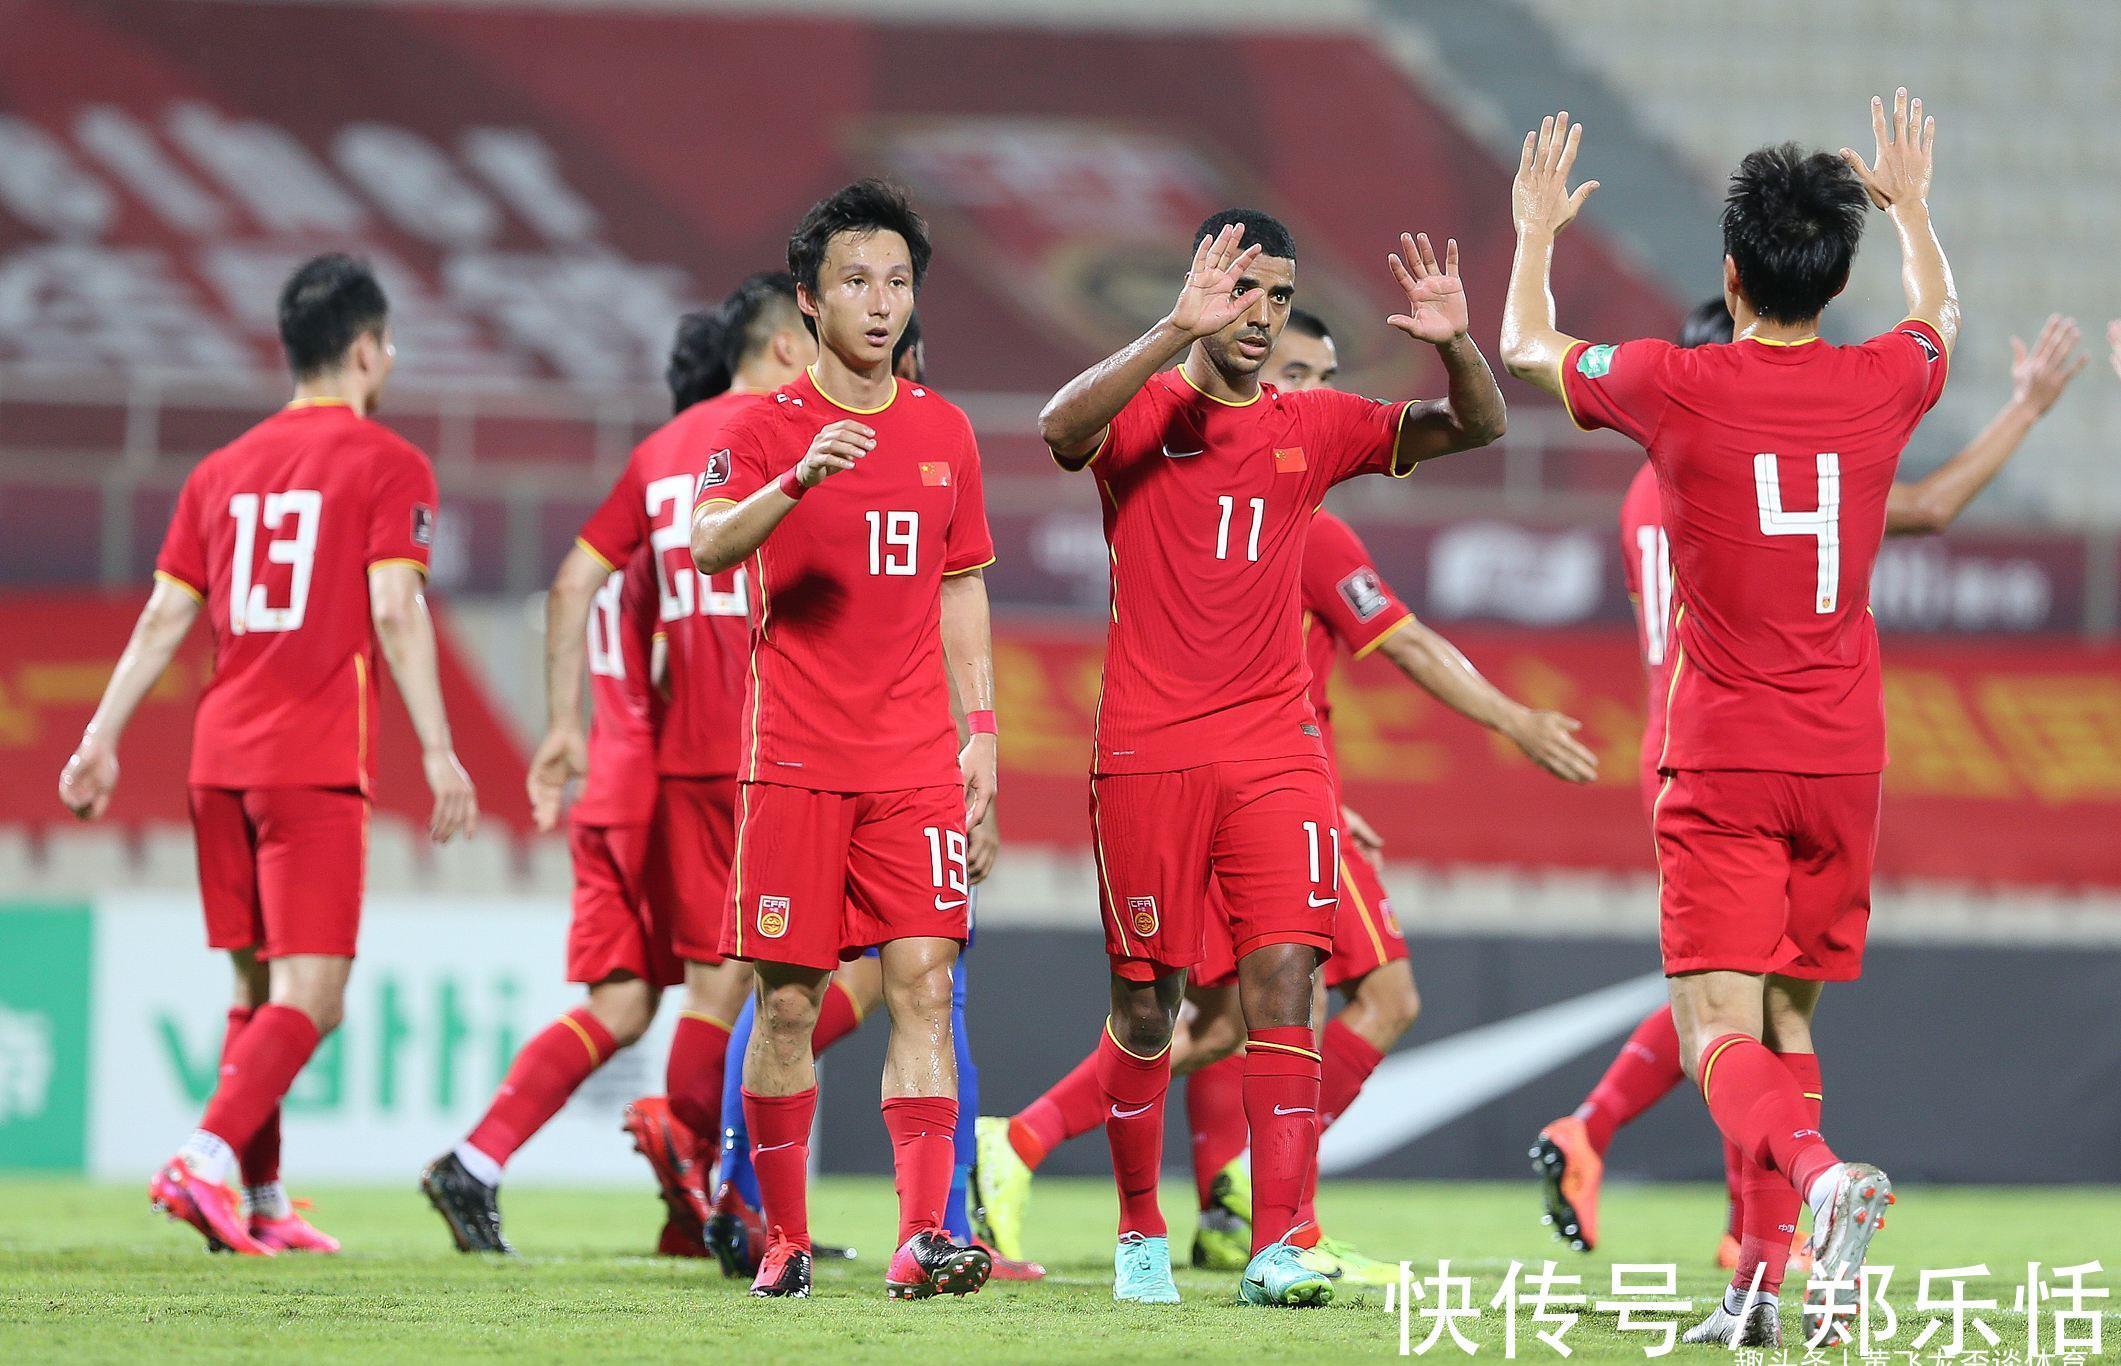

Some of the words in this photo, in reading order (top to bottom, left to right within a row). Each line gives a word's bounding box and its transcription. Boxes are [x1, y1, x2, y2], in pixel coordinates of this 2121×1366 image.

[865, 510, 919, 576] 19
[1216, 495, 1264, 562] 11
[1753, 452, 1840, 614] 4
[229, 490, 322, 635] 13
[923, 827, 968, 895] 19
[1303, 821, 1339, 891] 11
[763, 899, 787, 909] CFA
[1130, 900, 1152, 908] CFA
